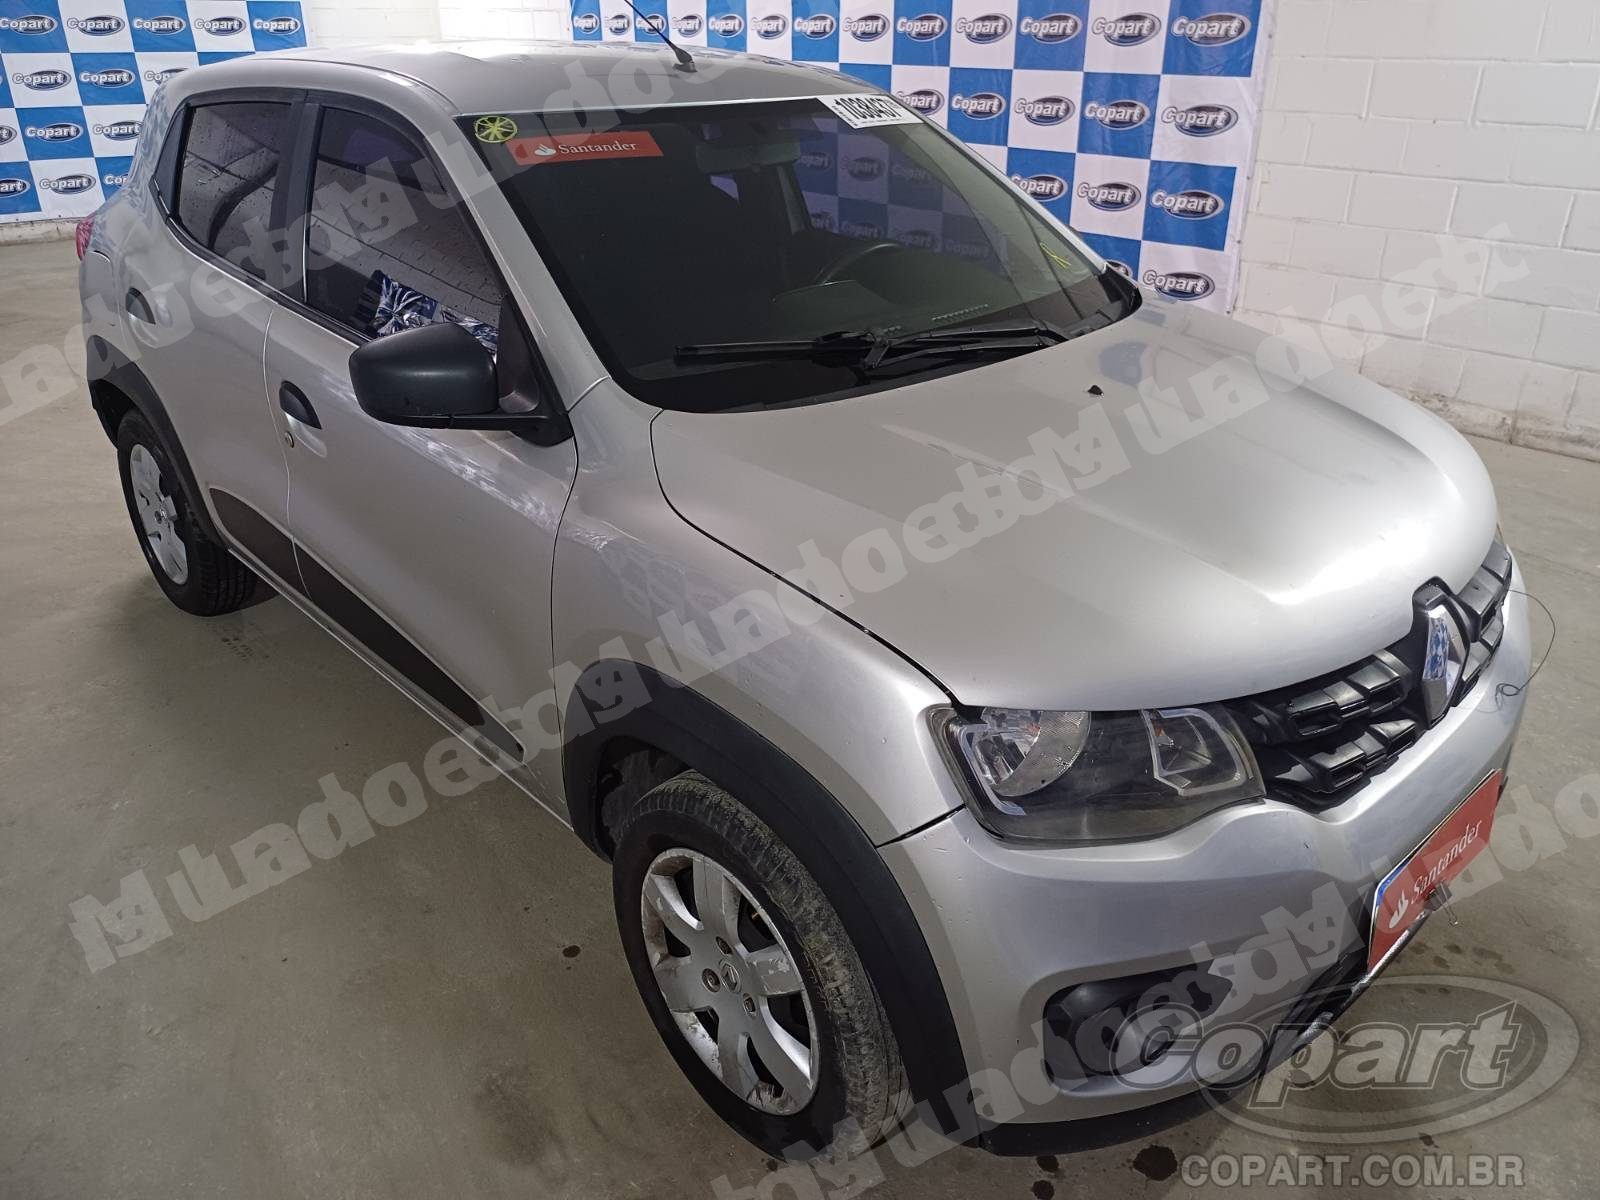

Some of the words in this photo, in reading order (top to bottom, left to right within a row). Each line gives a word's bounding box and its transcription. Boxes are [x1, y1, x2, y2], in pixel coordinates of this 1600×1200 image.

[0, 18, 50, 32] Copart
[67, 17, 118, 32] Copart
[134, 18, 180, 32] Copart
[194, 18, 240, 32] Copart
[253, 18, 296, 32] Copart
[708, 16, 739, 33] Copart
[751, 17, 783, 34] Copart
[794, 17, 831, 34] Copart
[843, 17, 883, 34] Copart
[897, 16, 940, 36] Copart
[956, 17, 1004, 36] Copart
[1020, 16, 1073, 38] Copart
[1092, 17, 1149, 40] Copart
[1171, 16, 1241, 42] Copart
[12, 72, 65, 87] Copart
[80, 71, 130, 85] Copart
[952, 94, 1000, 114] Copart
[1015, 98, 1066, 118] Copart
[1085, 101, 1141, 124] Copart
[1161, 106, 1226, 129] Copart
[26, 126, 77, 140] Copart
[92, 123, 140, 139] Copart
[558, 140, 639, 155] Santander
[39, 173, 89, 191] Copart
[1011, 174, 1060, 195] Copart
[1077, 182, 1133, 206] Copart
[1151, 191, 1218, 216] Copart
[1143, 269, 1207, 295] Copart
[1411, 820, 1482, 904] Santander
